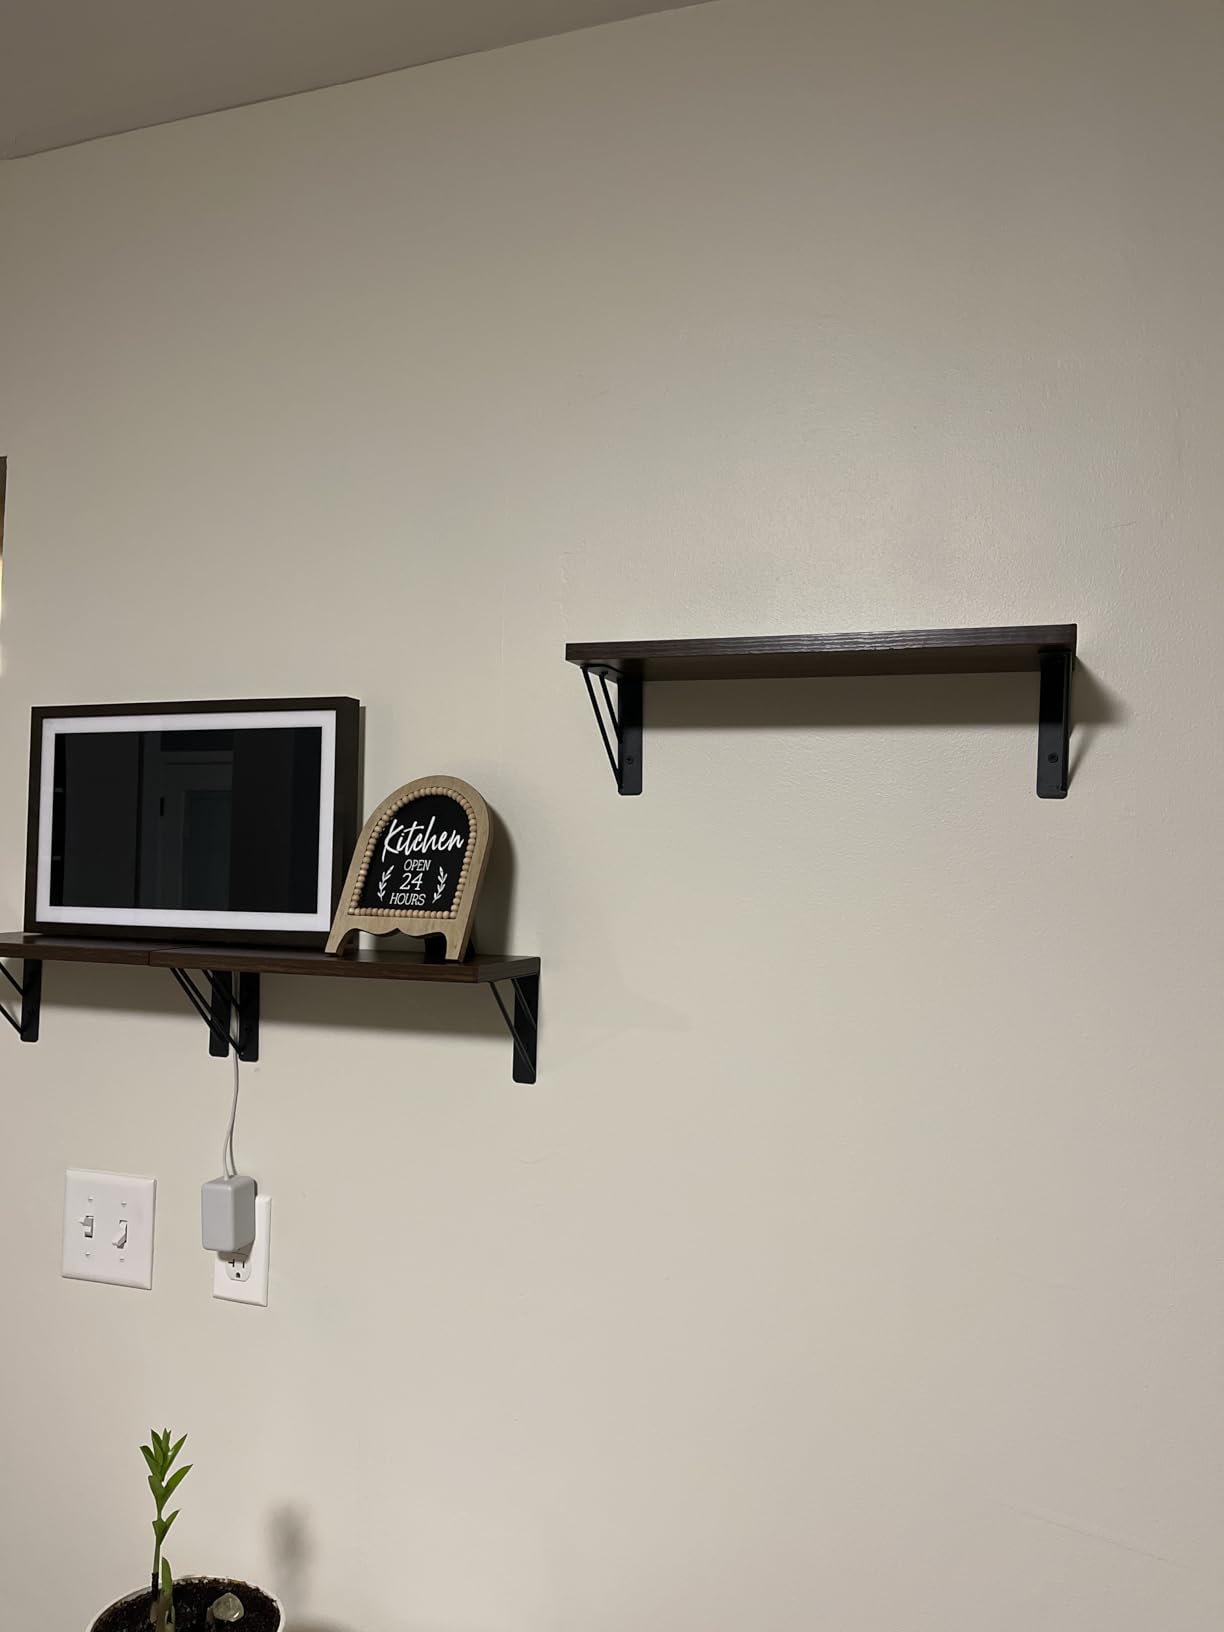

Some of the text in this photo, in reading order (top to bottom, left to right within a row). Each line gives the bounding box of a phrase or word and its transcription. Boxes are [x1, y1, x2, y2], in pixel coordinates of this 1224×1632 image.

[381, 815, 464, 863] Kitchen
[403, 859, 431, 871] OPEN
[399, 872, 423, 890] 24
[389, 892, 426, 905] HOURS
